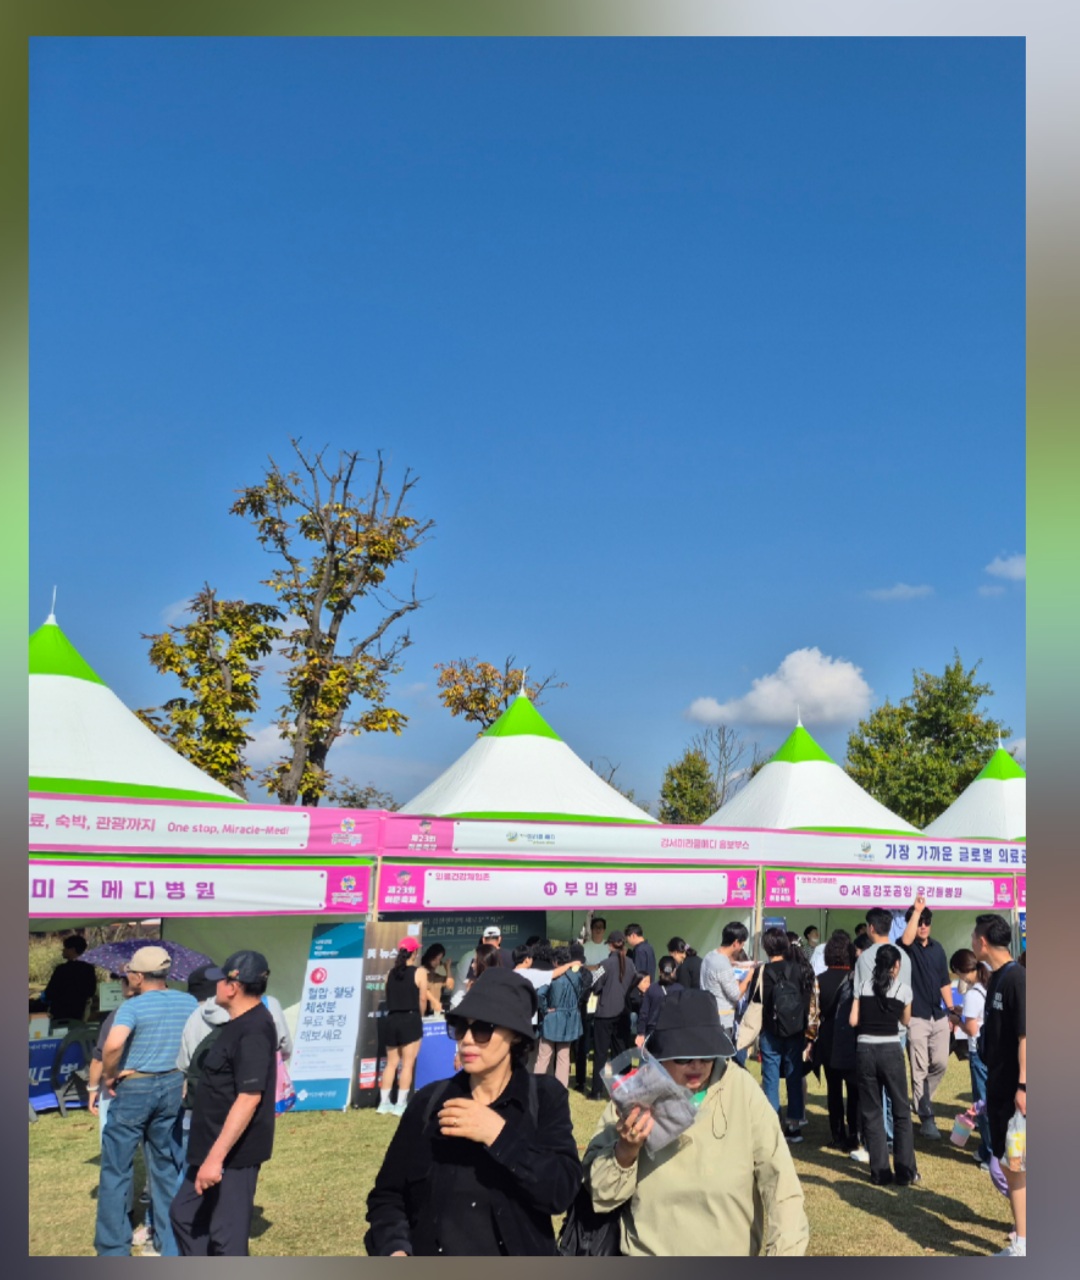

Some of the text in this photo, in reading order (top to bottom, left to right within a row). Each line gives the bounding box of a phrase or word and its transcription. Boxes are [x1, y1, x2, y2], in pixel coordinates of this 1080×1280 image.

[55, 813, 91, 832] 숙박,
[95, 815, 156, 833] 관광까지
[167, 822, 189, 834] One
[192, 822, 220, 836] stop,
[885, 843, 910, 861] 가장
[916, 844, 953, 862] 가까운
[959, 846, 993, 863] 글로벌
[31, 877, 217, 901] 미즈메디병원
[564, 880, 638, 897] 부민병원
[304, 1000, 337, 1014] 체성분
[302, 1014, 347, 1028] 무료 측정
[299, 1028, 343, 1042] 해보세요
